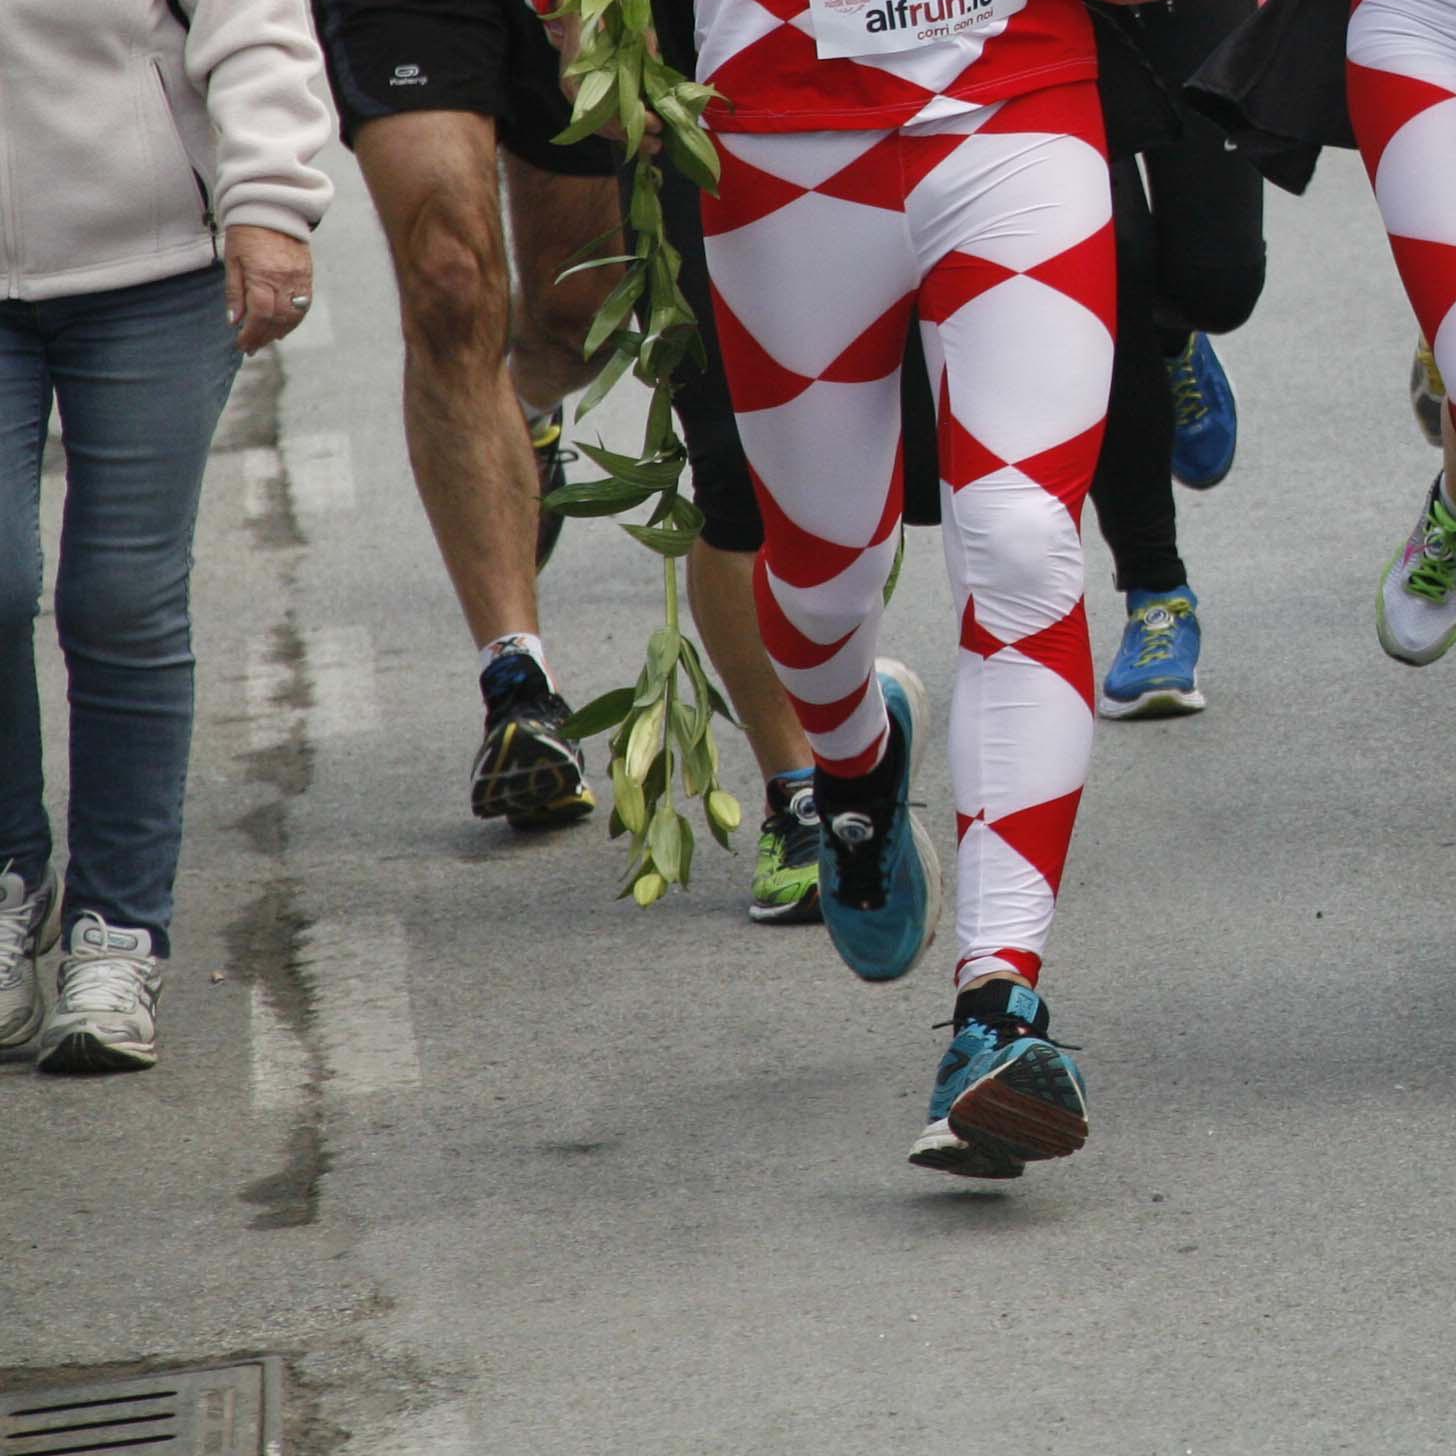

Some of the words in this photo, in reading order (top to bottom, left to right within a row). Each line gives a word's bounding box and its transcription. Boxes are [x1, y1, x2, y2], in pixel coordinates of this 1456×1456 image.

[917, 22, 949, 40] corri
[954, 18, 973, 32] con
[976, 7, 994, 21] noi
